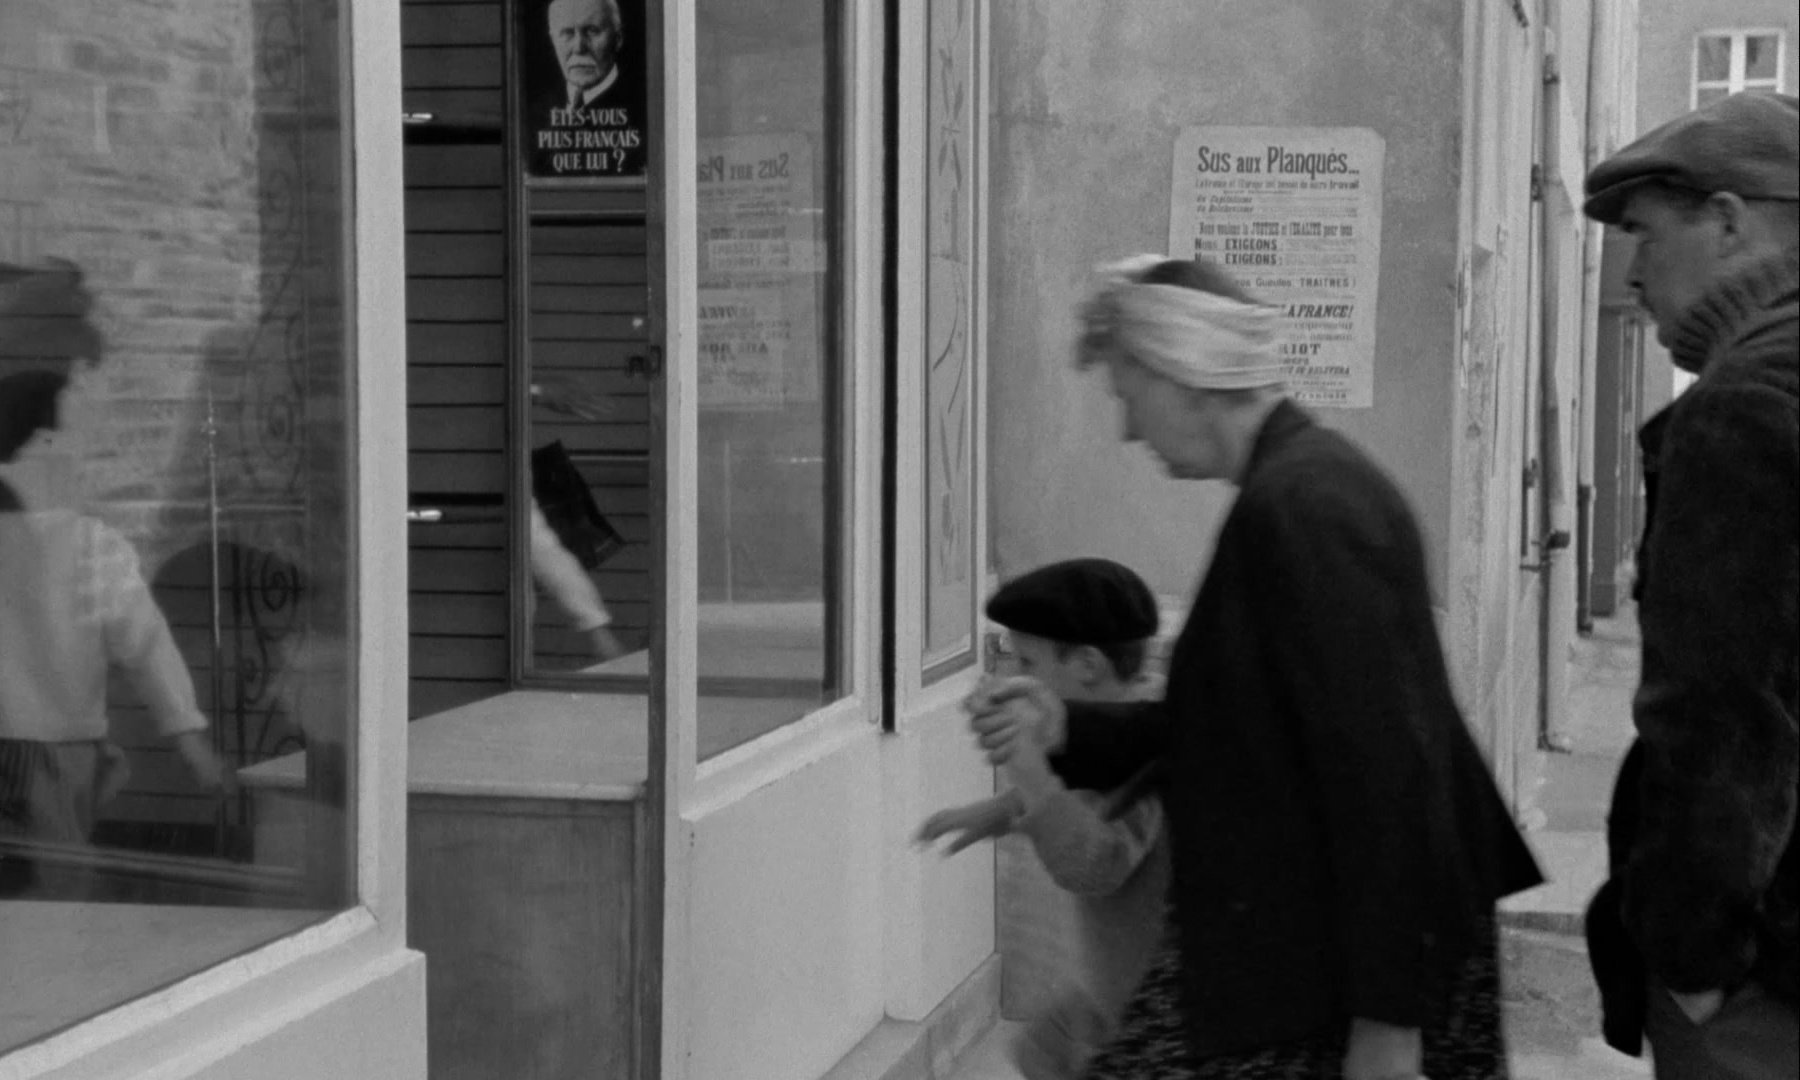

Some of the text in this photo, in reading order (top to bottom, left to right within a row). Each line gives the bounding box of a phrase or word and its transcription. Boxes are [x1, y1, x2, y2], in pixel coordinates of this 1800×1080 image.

[537, 130, 573, 148] PLUS
[552, 148, 626, 173] QUE LUI ?
[1198, 146, 1231, 173] Sus
[1236, 156, 1261, 174] aux
[1250, 221, 1279, 235] JUSTICE
[1323, 224, 1338, 238] pour
[1195, 238, 1217, 250] Nous
[1297, 303, 1354, 319] FRANCE!
